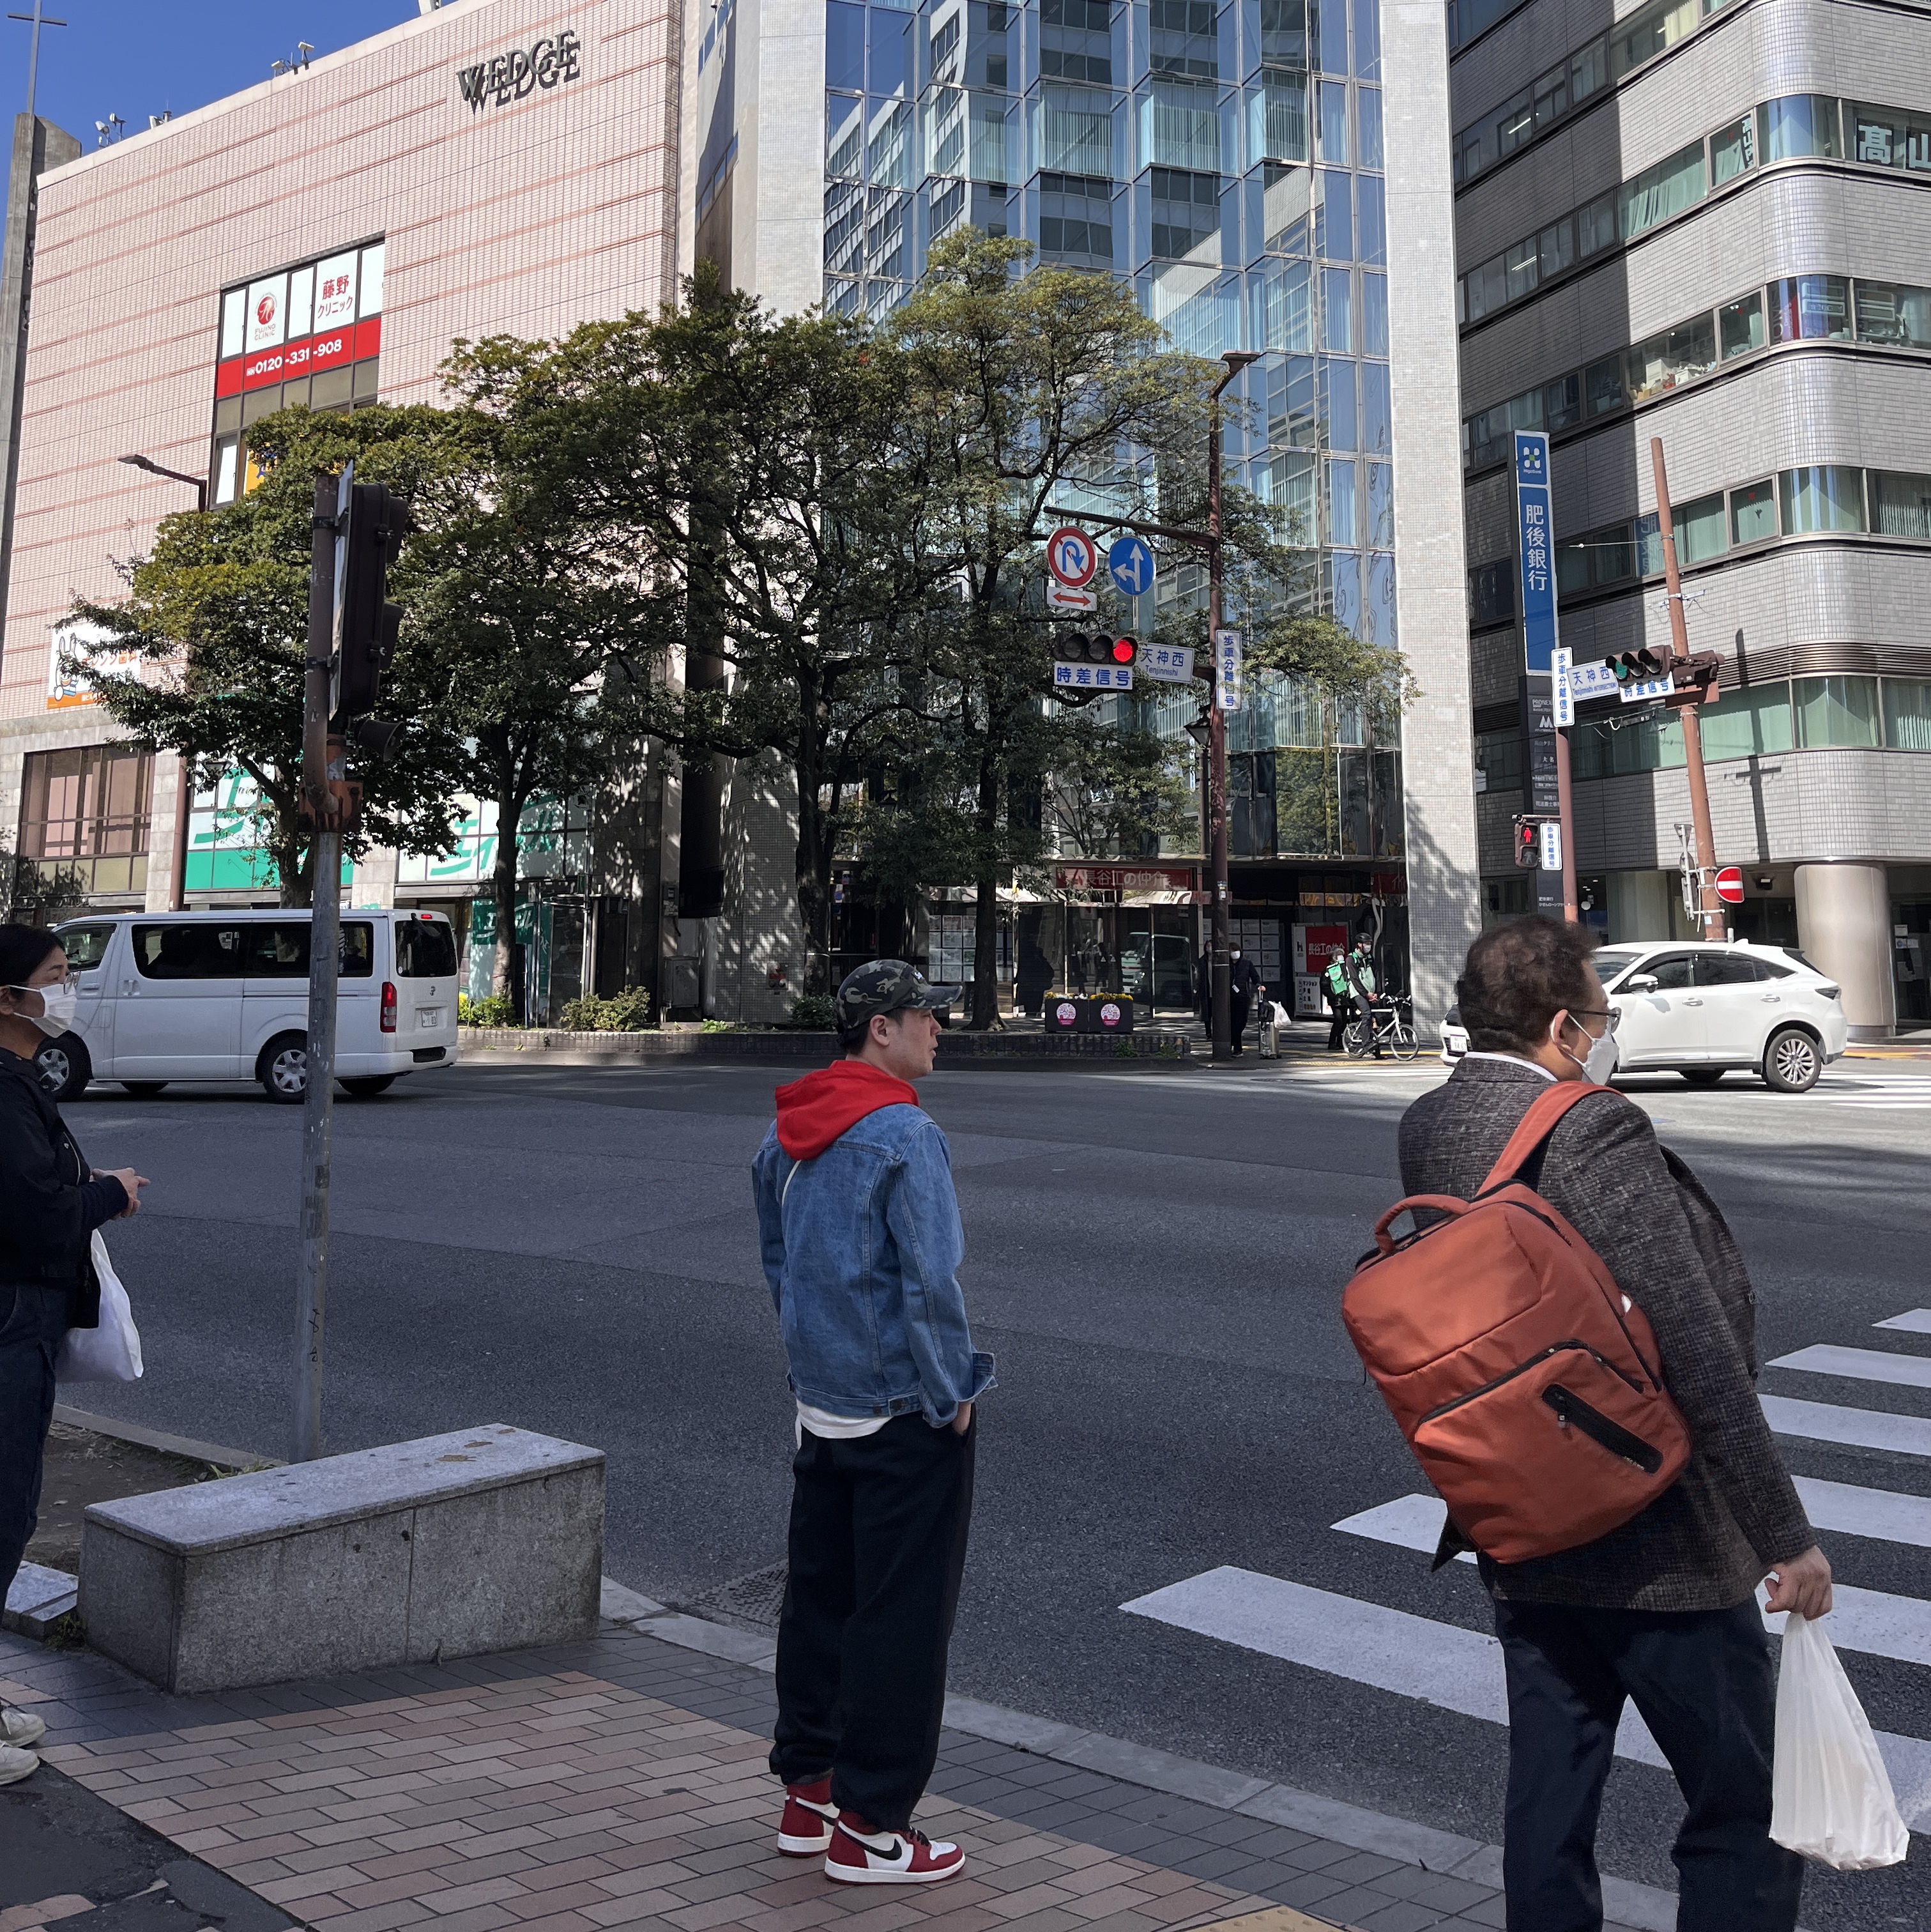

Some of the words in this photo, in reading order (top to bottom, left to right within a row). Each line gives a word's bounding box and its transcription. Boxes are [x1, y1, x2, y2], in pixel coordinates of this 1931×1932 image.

[456, 29, 576, 102] WEDGE
[322, 274, 349, 300] 藤野
[317, 296, 353, 319] クリニック
[254, 329, 275, 341] CLINIC
[255, 323, 276, 335] FUJINO
[1525, 503, 1548, 591] 肥後銀行
[1140, 648, 1185, 668] 天神西
[1056, 666, 1131, 687] 時差信号
[1144, 664, 1179, 677] Tenjinnishi
[1572, 666, 1610, 686] 天神西
[1557, 652, 1569, 722] 歩車分離信号
